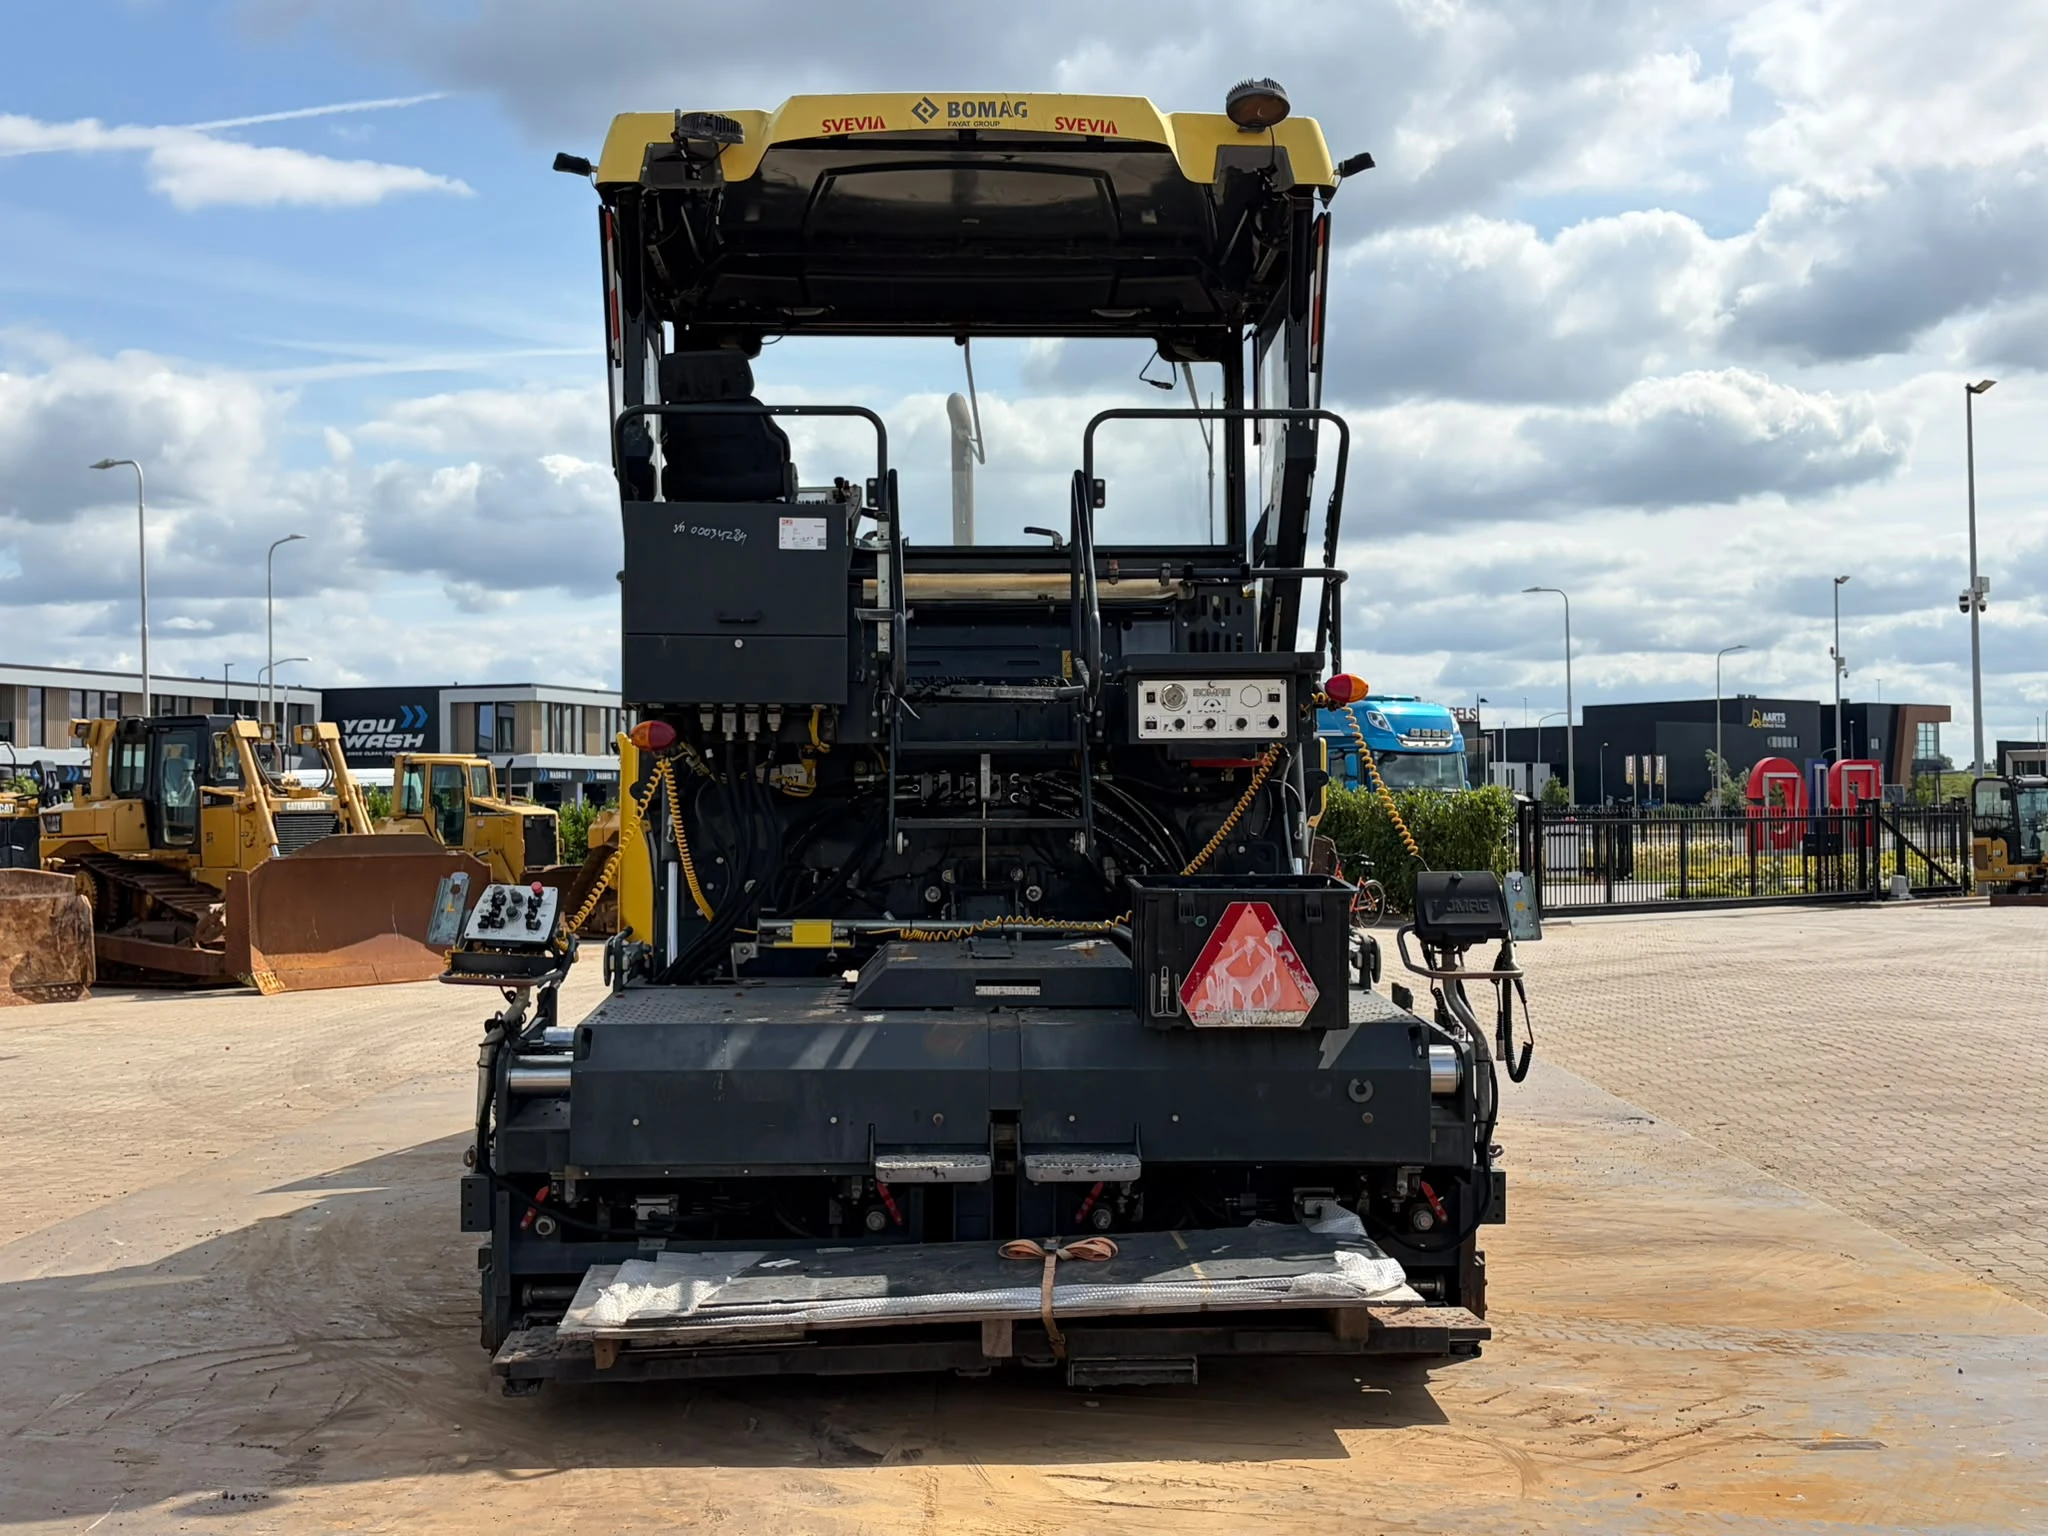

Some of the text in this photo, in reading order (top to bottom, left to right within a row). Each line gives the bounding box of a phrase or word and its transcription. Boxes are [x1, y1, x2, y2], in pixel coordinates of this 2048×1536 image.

[947, 101, 1028, 118] BOMAG
[822, 115, 886, 133] SVEVIA
[1055, 116, 1118, 134] SVEVIA
[342, 719, 396, 733] YOU
[343, 734, 425, 748] WASH
